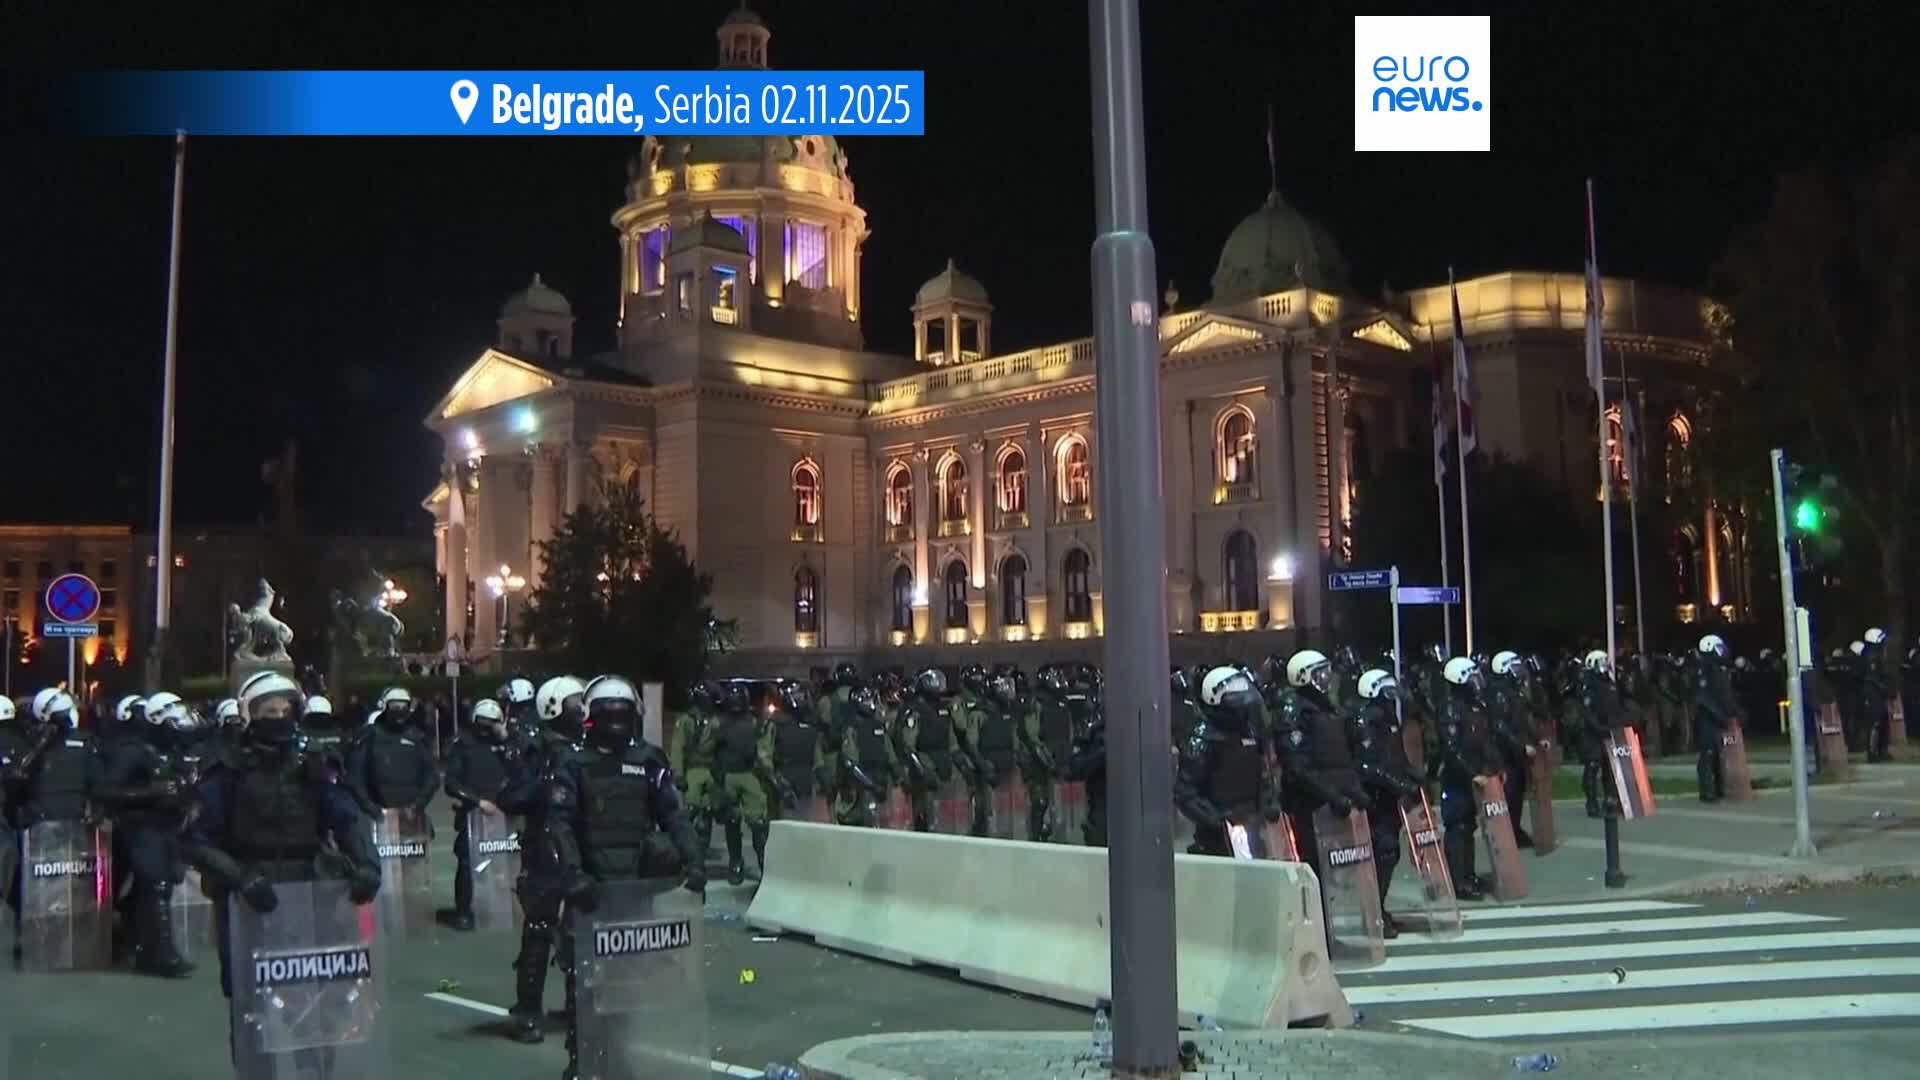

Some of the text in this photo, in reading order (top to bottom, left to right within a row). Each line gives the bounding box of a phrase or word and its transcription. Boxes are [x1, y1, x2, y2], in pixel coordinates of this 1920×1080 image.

[377, 843, 425, 858] ОЛИЦИЈА
[479, 839, 521, 853] ПОЛИЦИ
[596, 923, 690, 955] ПОЛИЦИЈА
[255, 951, 370, 982] ПОЛИЦИЈА
